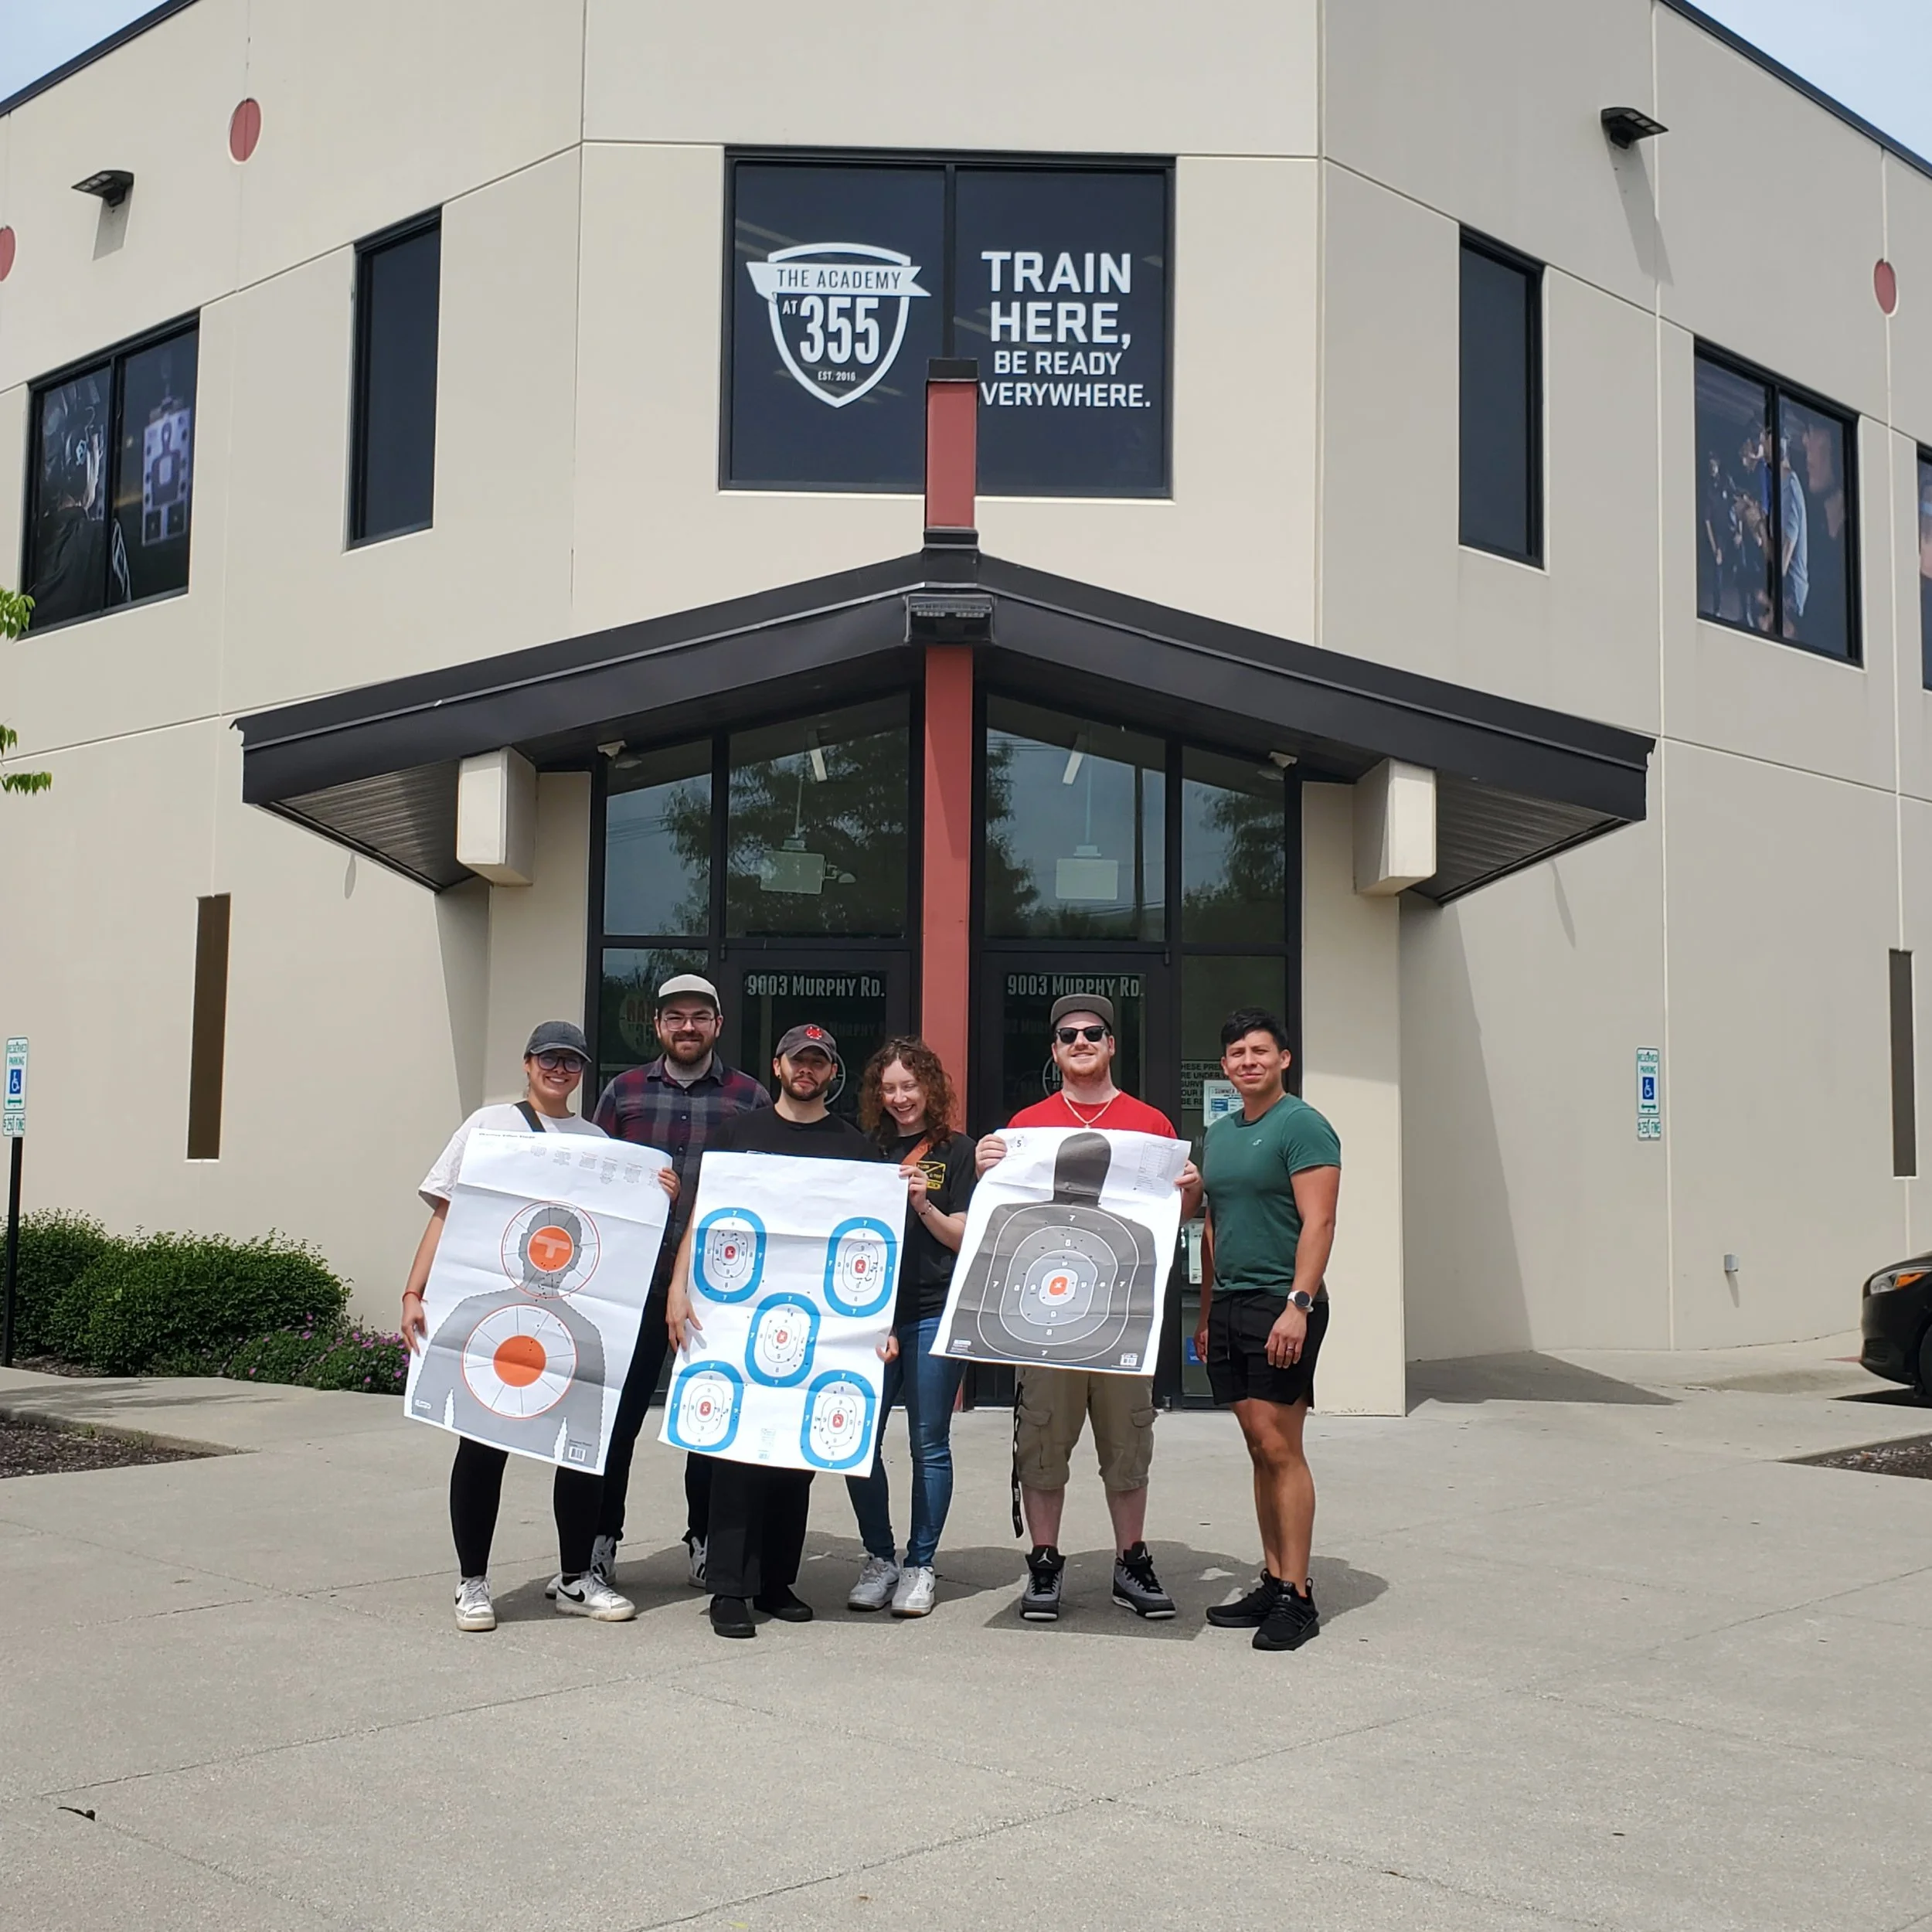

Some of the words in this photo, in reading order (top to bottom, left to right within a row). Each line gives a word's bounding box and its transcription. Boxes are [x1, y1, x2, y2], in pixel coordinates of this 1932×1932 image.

[777, 268, 810, 288] THE
[816, 268, 902, 291] ACADEMY
[981, 251, 1131, 294] TRAIN
[782, 300, 798, 315] AT
[799, 296, 880, 364] 355
[990, 301, 1131, 349] HERE,
[995, 351, 1027, 375] BE
[1036, 352, 1122, 376] READY
[818, 371, 833, 382] EST.
[835, 371, 856, 382] 2016
[980, 382, 1151, 408] VERYWHERE.
[747, 975, 788, 996] 9003
[792, 975, 856, 997] MURPHY
[860, 976, 886, 998] RD.
[1008, 975, 1048, 995] 9003
[1016, 1139, 1022, 1148] 5
[1054, 1281, 1063, 1289] X
